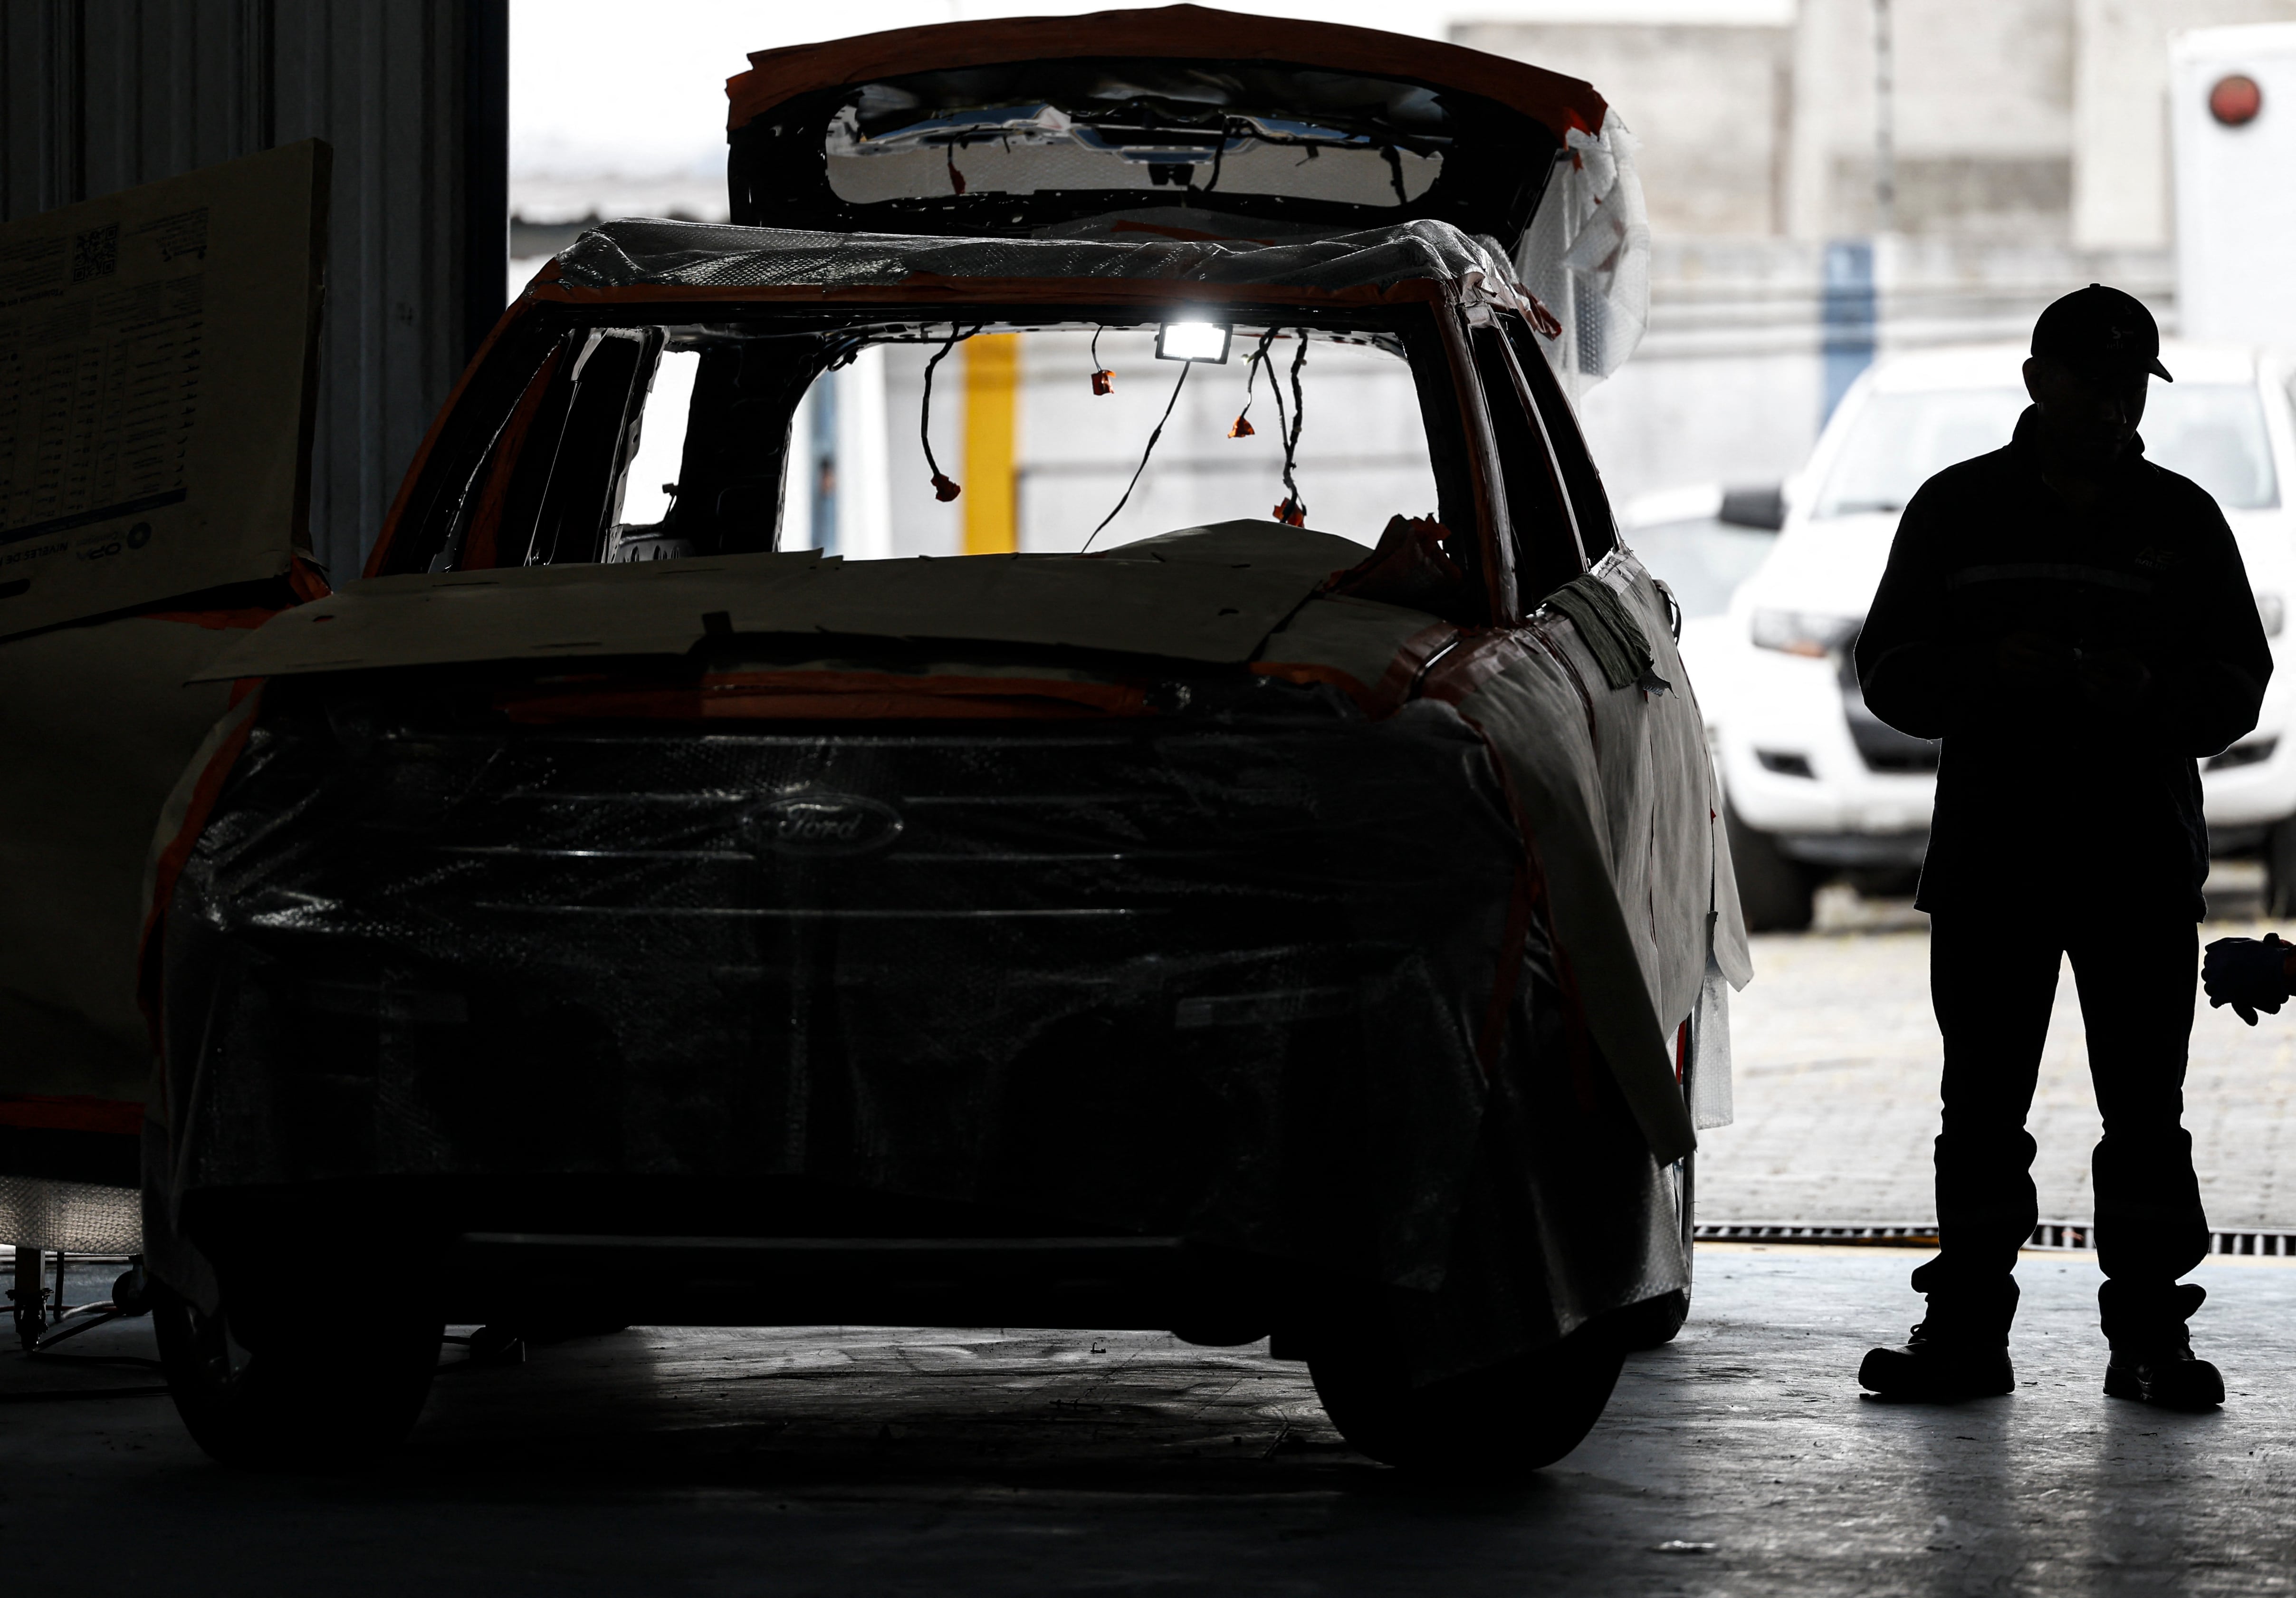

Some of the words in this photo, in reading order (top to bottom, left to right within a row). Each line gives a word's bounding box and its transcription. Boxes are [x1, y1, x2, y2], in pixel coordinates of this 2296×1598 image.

[6, 552, 21, 565] DE
[24, 541, 68, 561] NIVELES
[777, 805, 863, 839] Ford
